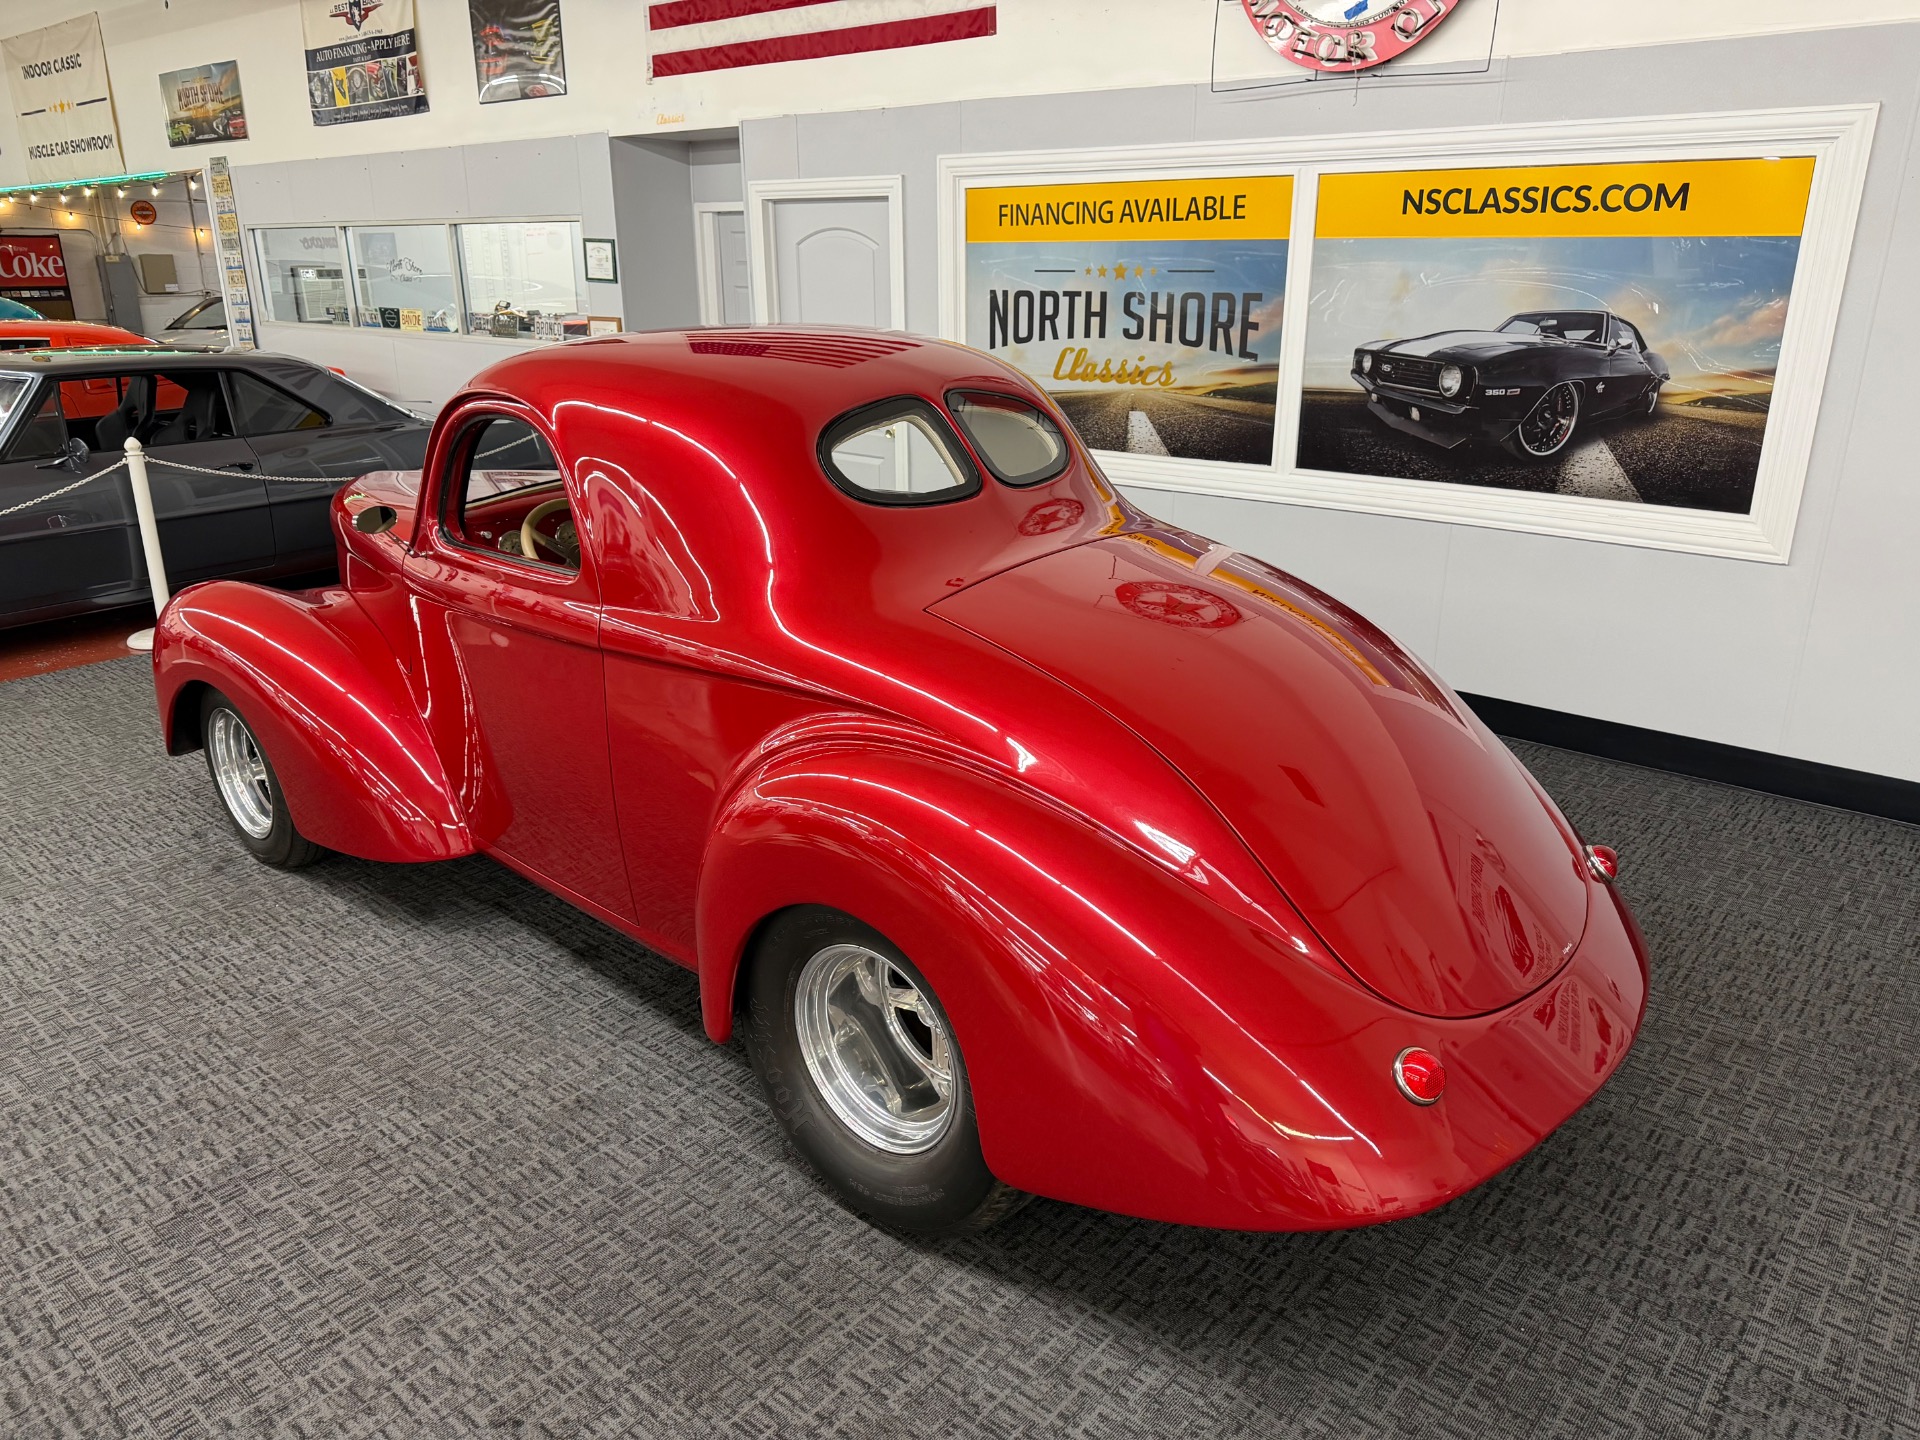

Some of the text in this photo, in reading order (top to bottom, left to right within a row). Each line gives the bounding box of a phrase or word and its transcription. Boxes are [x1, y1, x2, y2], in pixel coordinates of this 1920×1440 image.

[334, 2, 348, 13] BEST
[316, 49, 333, 62] AUTO
[332, 42, 367, 59] FINANCING
[371, 37, 394, 52] APPLY
[394, 33, 411, 47] HERE
[21, 52, 82, 80] INDOOR CLASSIC
[176, 86, 200, 111] NORTH
[27, 133, 115, 160] MUSCLE CAR SHOWROOM
[998, 194, 1247, 227] FINANCING AVAILABLE
[1401, 182, 1690, 215] NSCLASSICS.COM
[0, 246, 65, 279] Coke
[535, 320, 563, 340] BRONCO
[988, 289, 1263, 363] NORTH SHORE
[1052, 347, 1178, 387] Classics
[1485, 388, 1506, 396] 350
